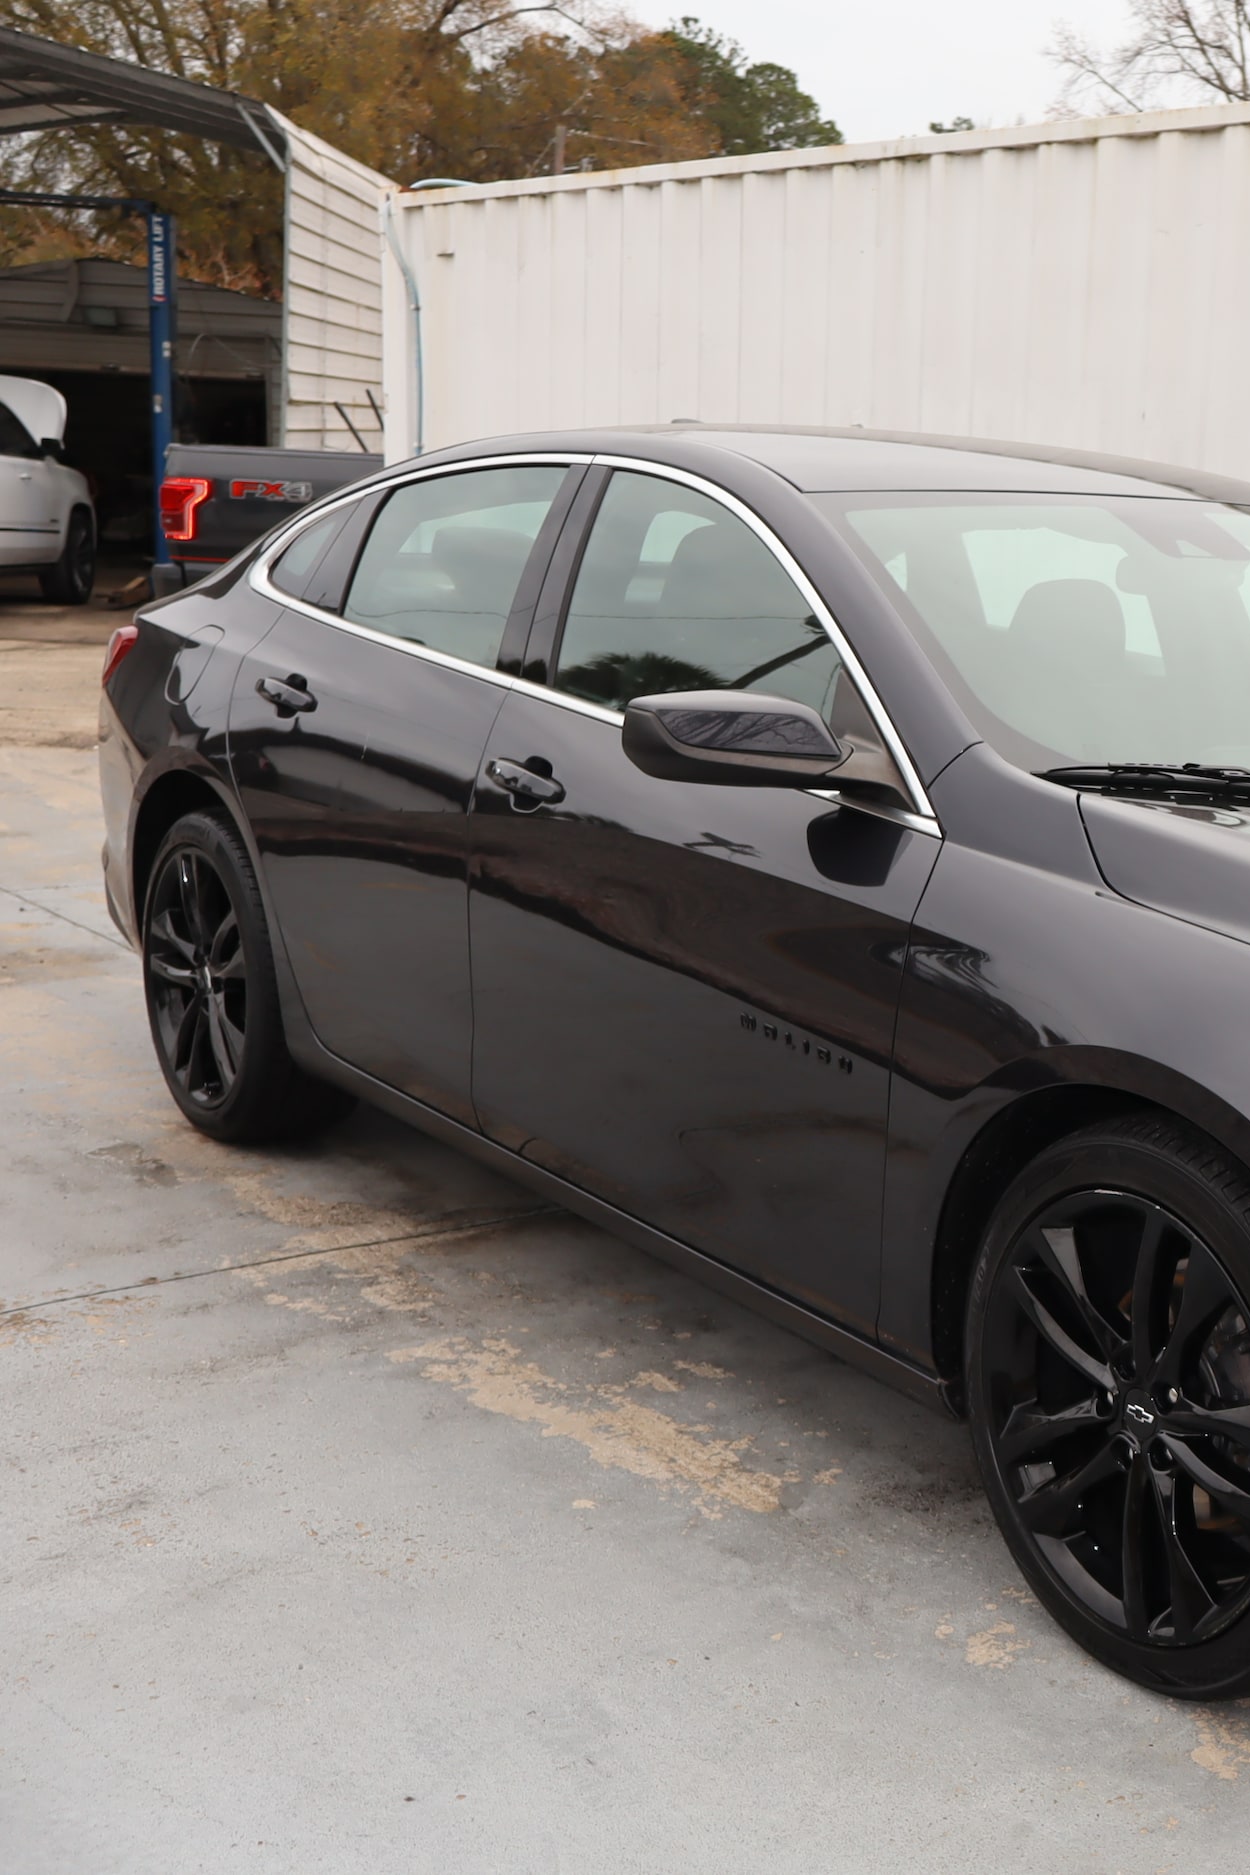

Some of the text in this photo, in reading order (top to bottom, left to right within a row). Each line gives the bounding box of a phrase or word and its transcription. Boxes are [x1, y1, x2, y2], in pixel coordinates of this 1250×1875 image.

[152, 215, 165, 295] ROTARY LIFT
[229, 478, 313, 503] FX4
